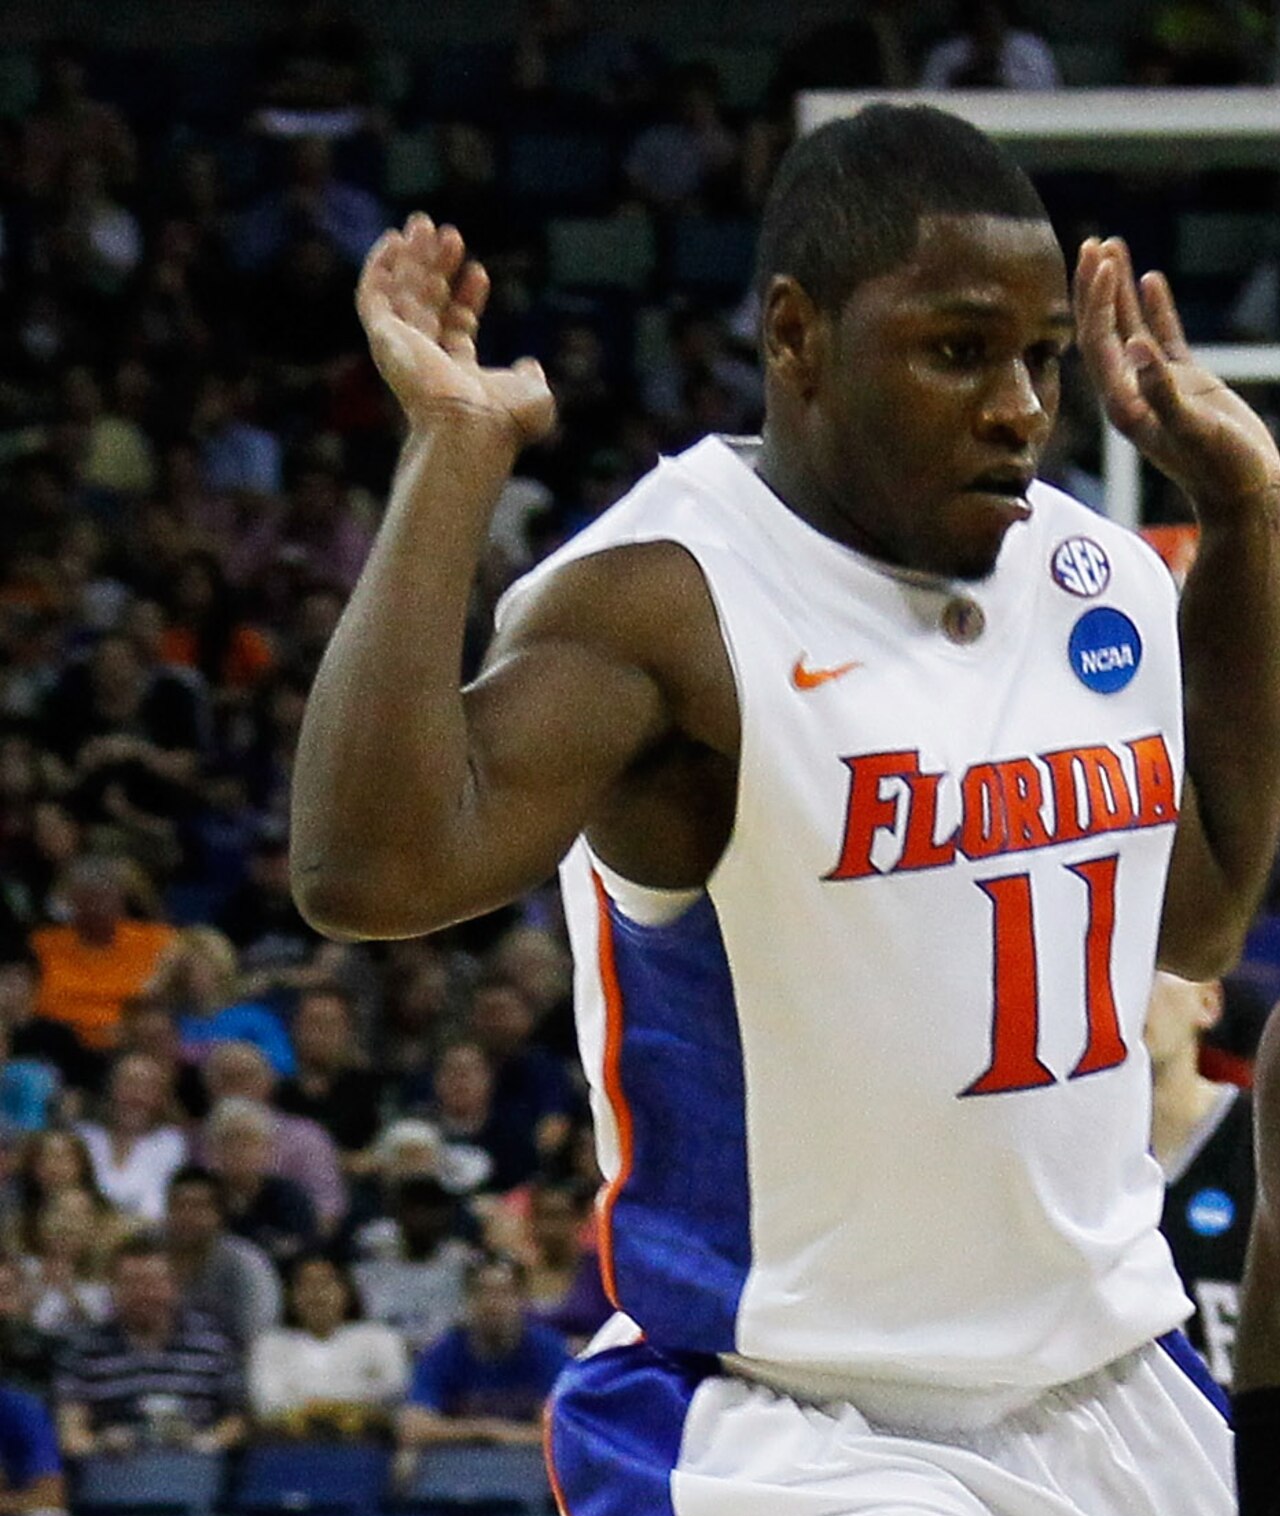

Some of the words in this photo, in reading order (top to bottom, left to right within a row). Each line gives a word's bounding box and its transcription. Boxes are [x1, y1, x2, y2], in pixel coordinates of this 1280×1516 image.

[1080, 643, 1134, 674] NCAA
[820, 734, 1180, 882] FLORIDA
[956, 853, 1128, 1098] 11
